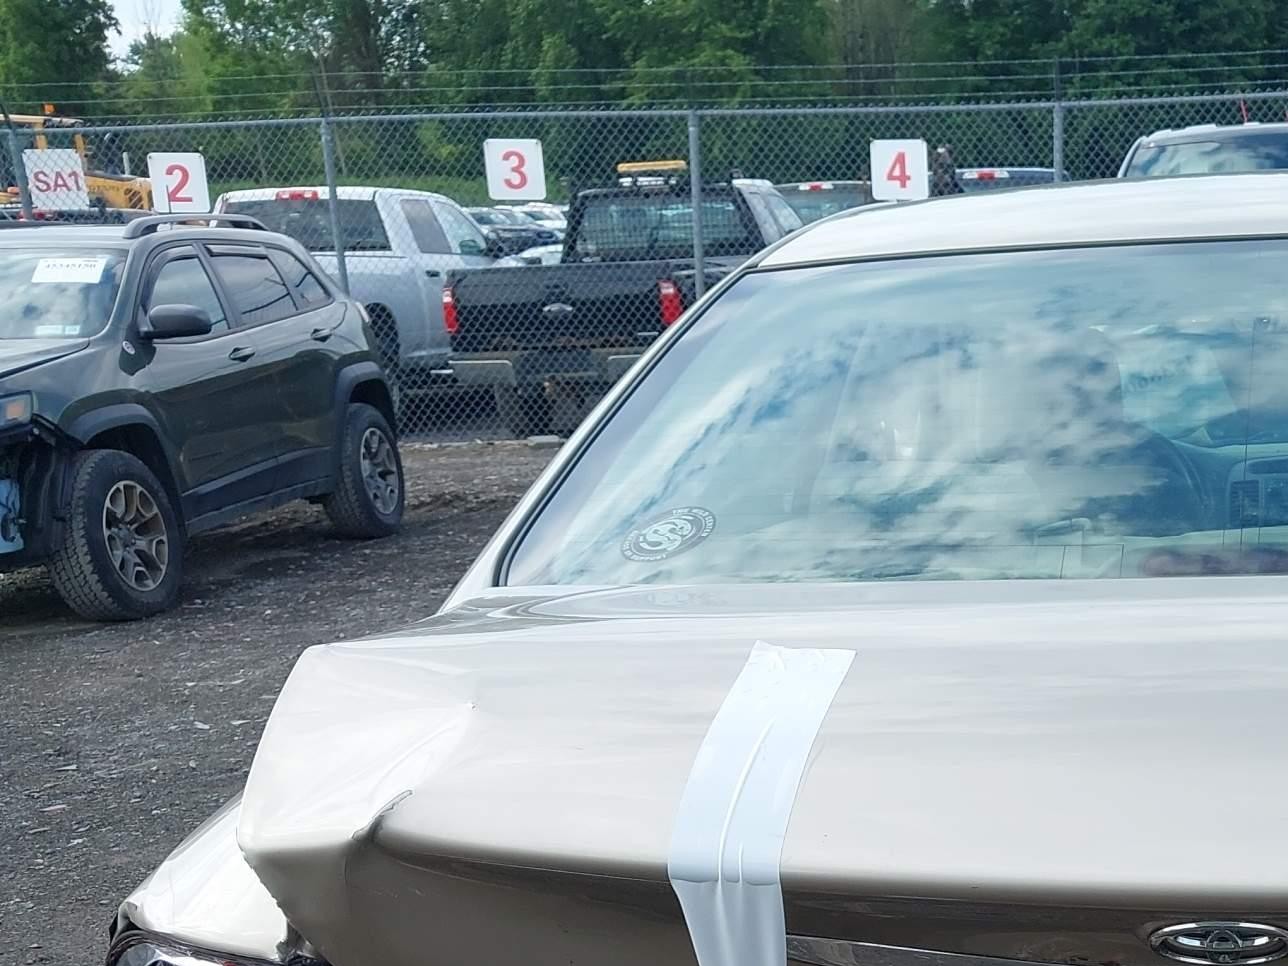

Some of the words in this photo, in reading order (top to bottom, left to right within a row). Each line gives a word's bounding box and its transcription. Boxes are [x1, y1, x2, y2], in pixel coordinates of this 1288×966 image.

[33, 170, 82, 193] SA1
[165, 164, 193, 203] 2
[502, 150, 528, 190] 3
[886, 151, 911, 188] 4
